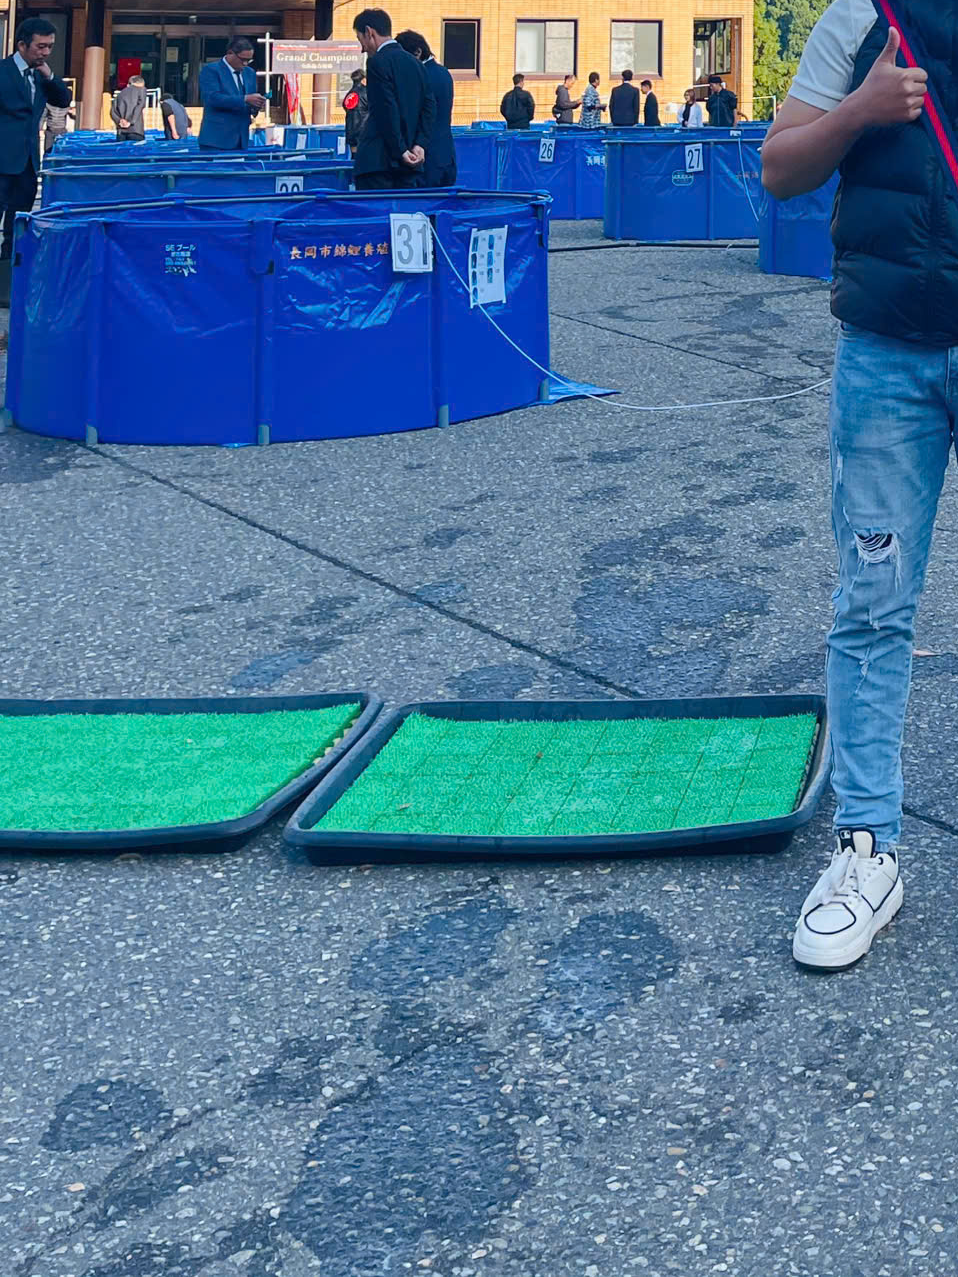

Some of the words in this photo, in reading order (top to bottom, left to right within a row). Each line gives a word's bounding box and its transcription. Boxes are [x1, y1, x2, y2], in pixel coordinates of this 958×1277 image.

[276, 52, 306, 62] Grand
[309, 52, 358, 64] Champion
[540, 142, 553, 160] 26
[687, 148, 701, 170] 27
[397, 223, 428, 266] 31
